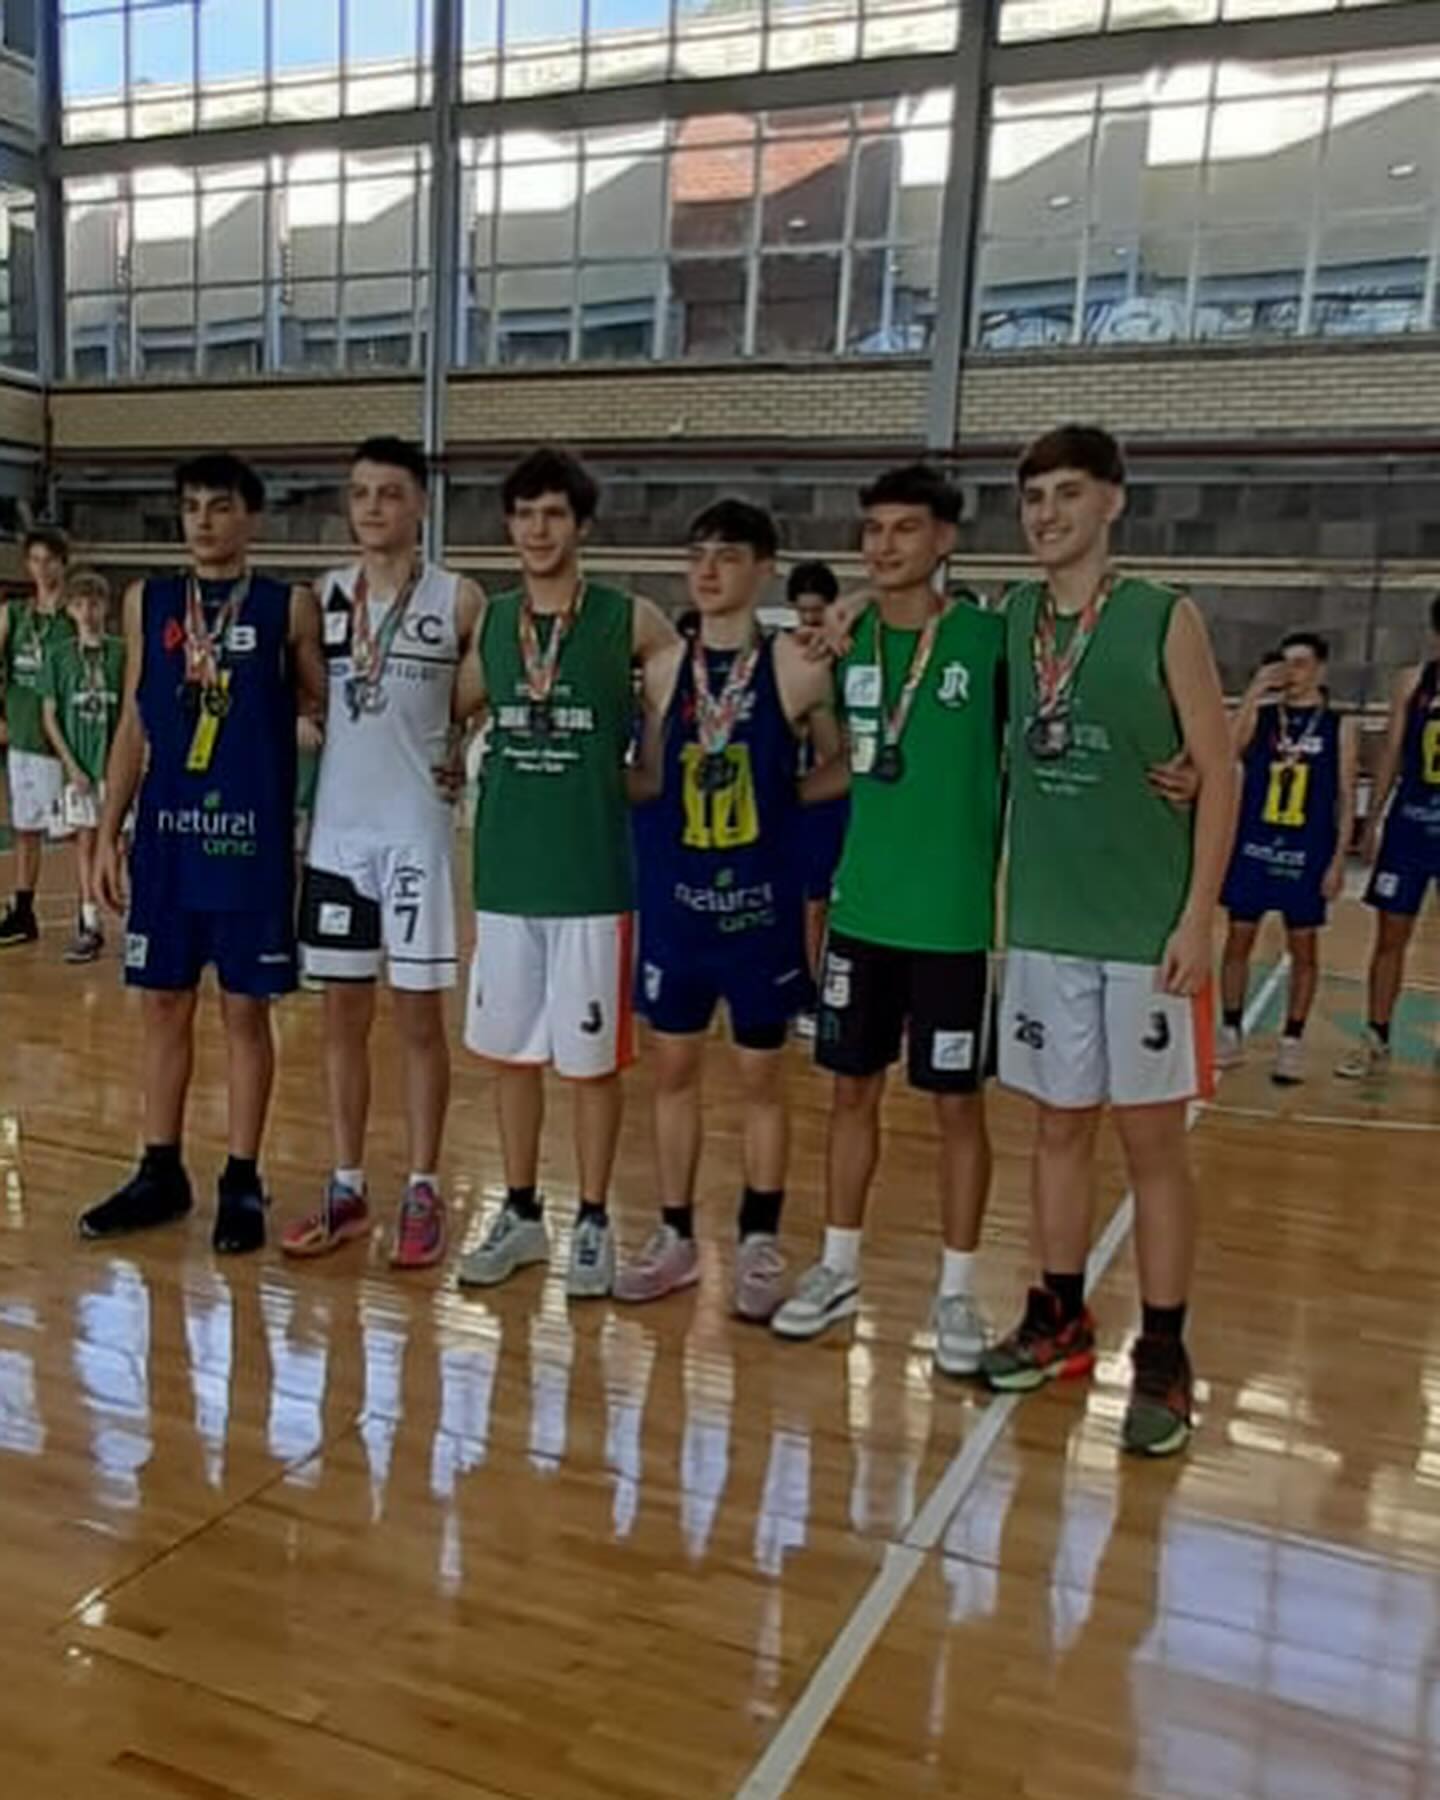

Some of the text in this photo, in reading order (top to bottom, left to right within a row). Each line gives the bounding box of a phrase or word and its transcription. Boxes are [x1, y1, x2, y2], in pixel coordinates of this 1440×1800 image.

[157, 808, 256, 836] natural
[395, 904, 419, 944] 7
[1141, 1010, 1170, 1052] 3
